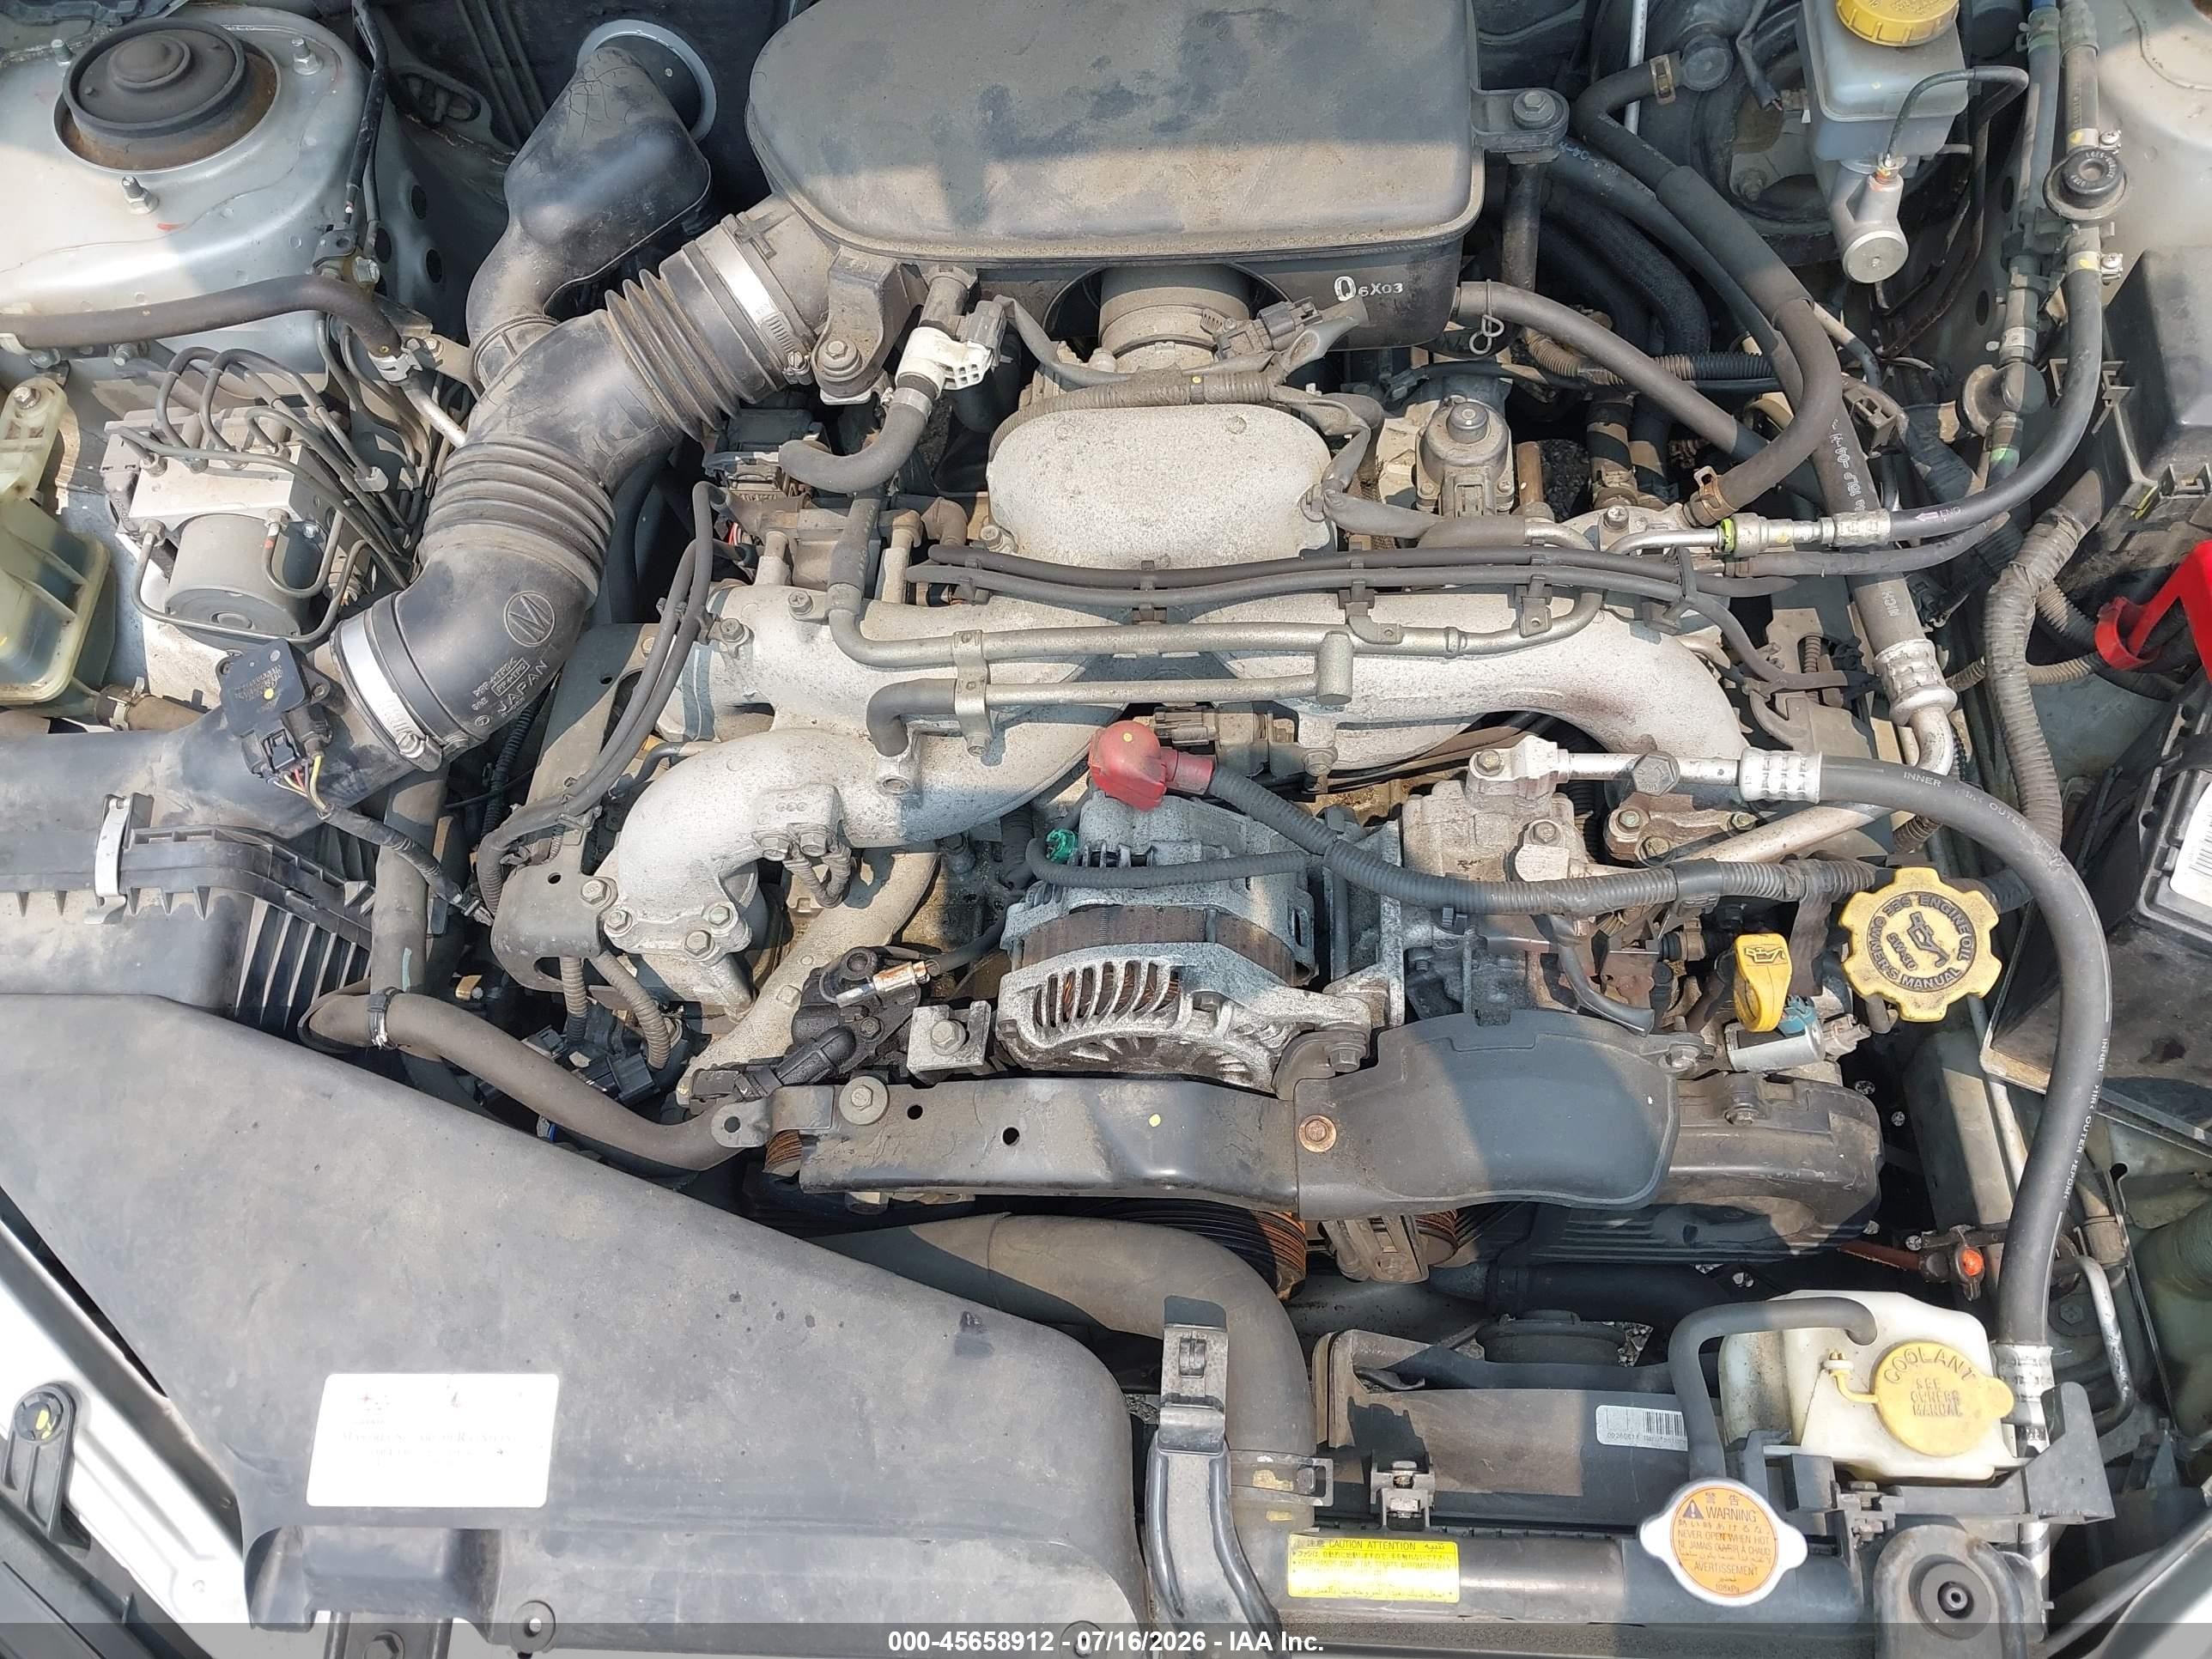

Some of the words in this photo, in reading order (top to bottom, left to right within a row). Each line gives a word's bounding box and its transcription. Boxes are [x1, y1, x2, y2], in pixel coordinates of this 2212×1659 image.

[497, 659, 549, 713] JAPAN
[1903, 771, 1942, 787] INNER
[1918, 895, 1971, 934] ENGINE
[1958, 935, 1973, 961] OIL
[1883, 895, 1913, 917] SEE
[1900, 967, 1962, 989] MANUAL
[1886, 932, 1918, 972] 5W-30
[2097, 1038, 2109, 1073] INNER
[2075, 1115, 2092, 1155] OUTER
[1883, 1346, 1976, 1384] COOLANT
[1916, 1377, 1941, 1390] SEE
[1912, 1403, 1963, 1417] MANUAL
[1705, 1505, 1757, 1522] WARNING
[1329, 1540, 1363, 1549] CAUTION
[1367, 1540, 1416, 1551] ATTENTION
[1678, 1529, 1703, 1540] NEVER
[1705, 1531, 1725, 1541] OPEN
[1728, 1533, 1752, 1544] WHEN
[1754, 1535, 1770, 1545] HOT
[1678, 1539, 1686, 1547] NE
[1689, 1540, 1712, 1551] JAMAIS
[1748, 1546, 1771, 1556] CHAUD
[1694, 1561, 1759, 1577] AVERTISSEMENT
